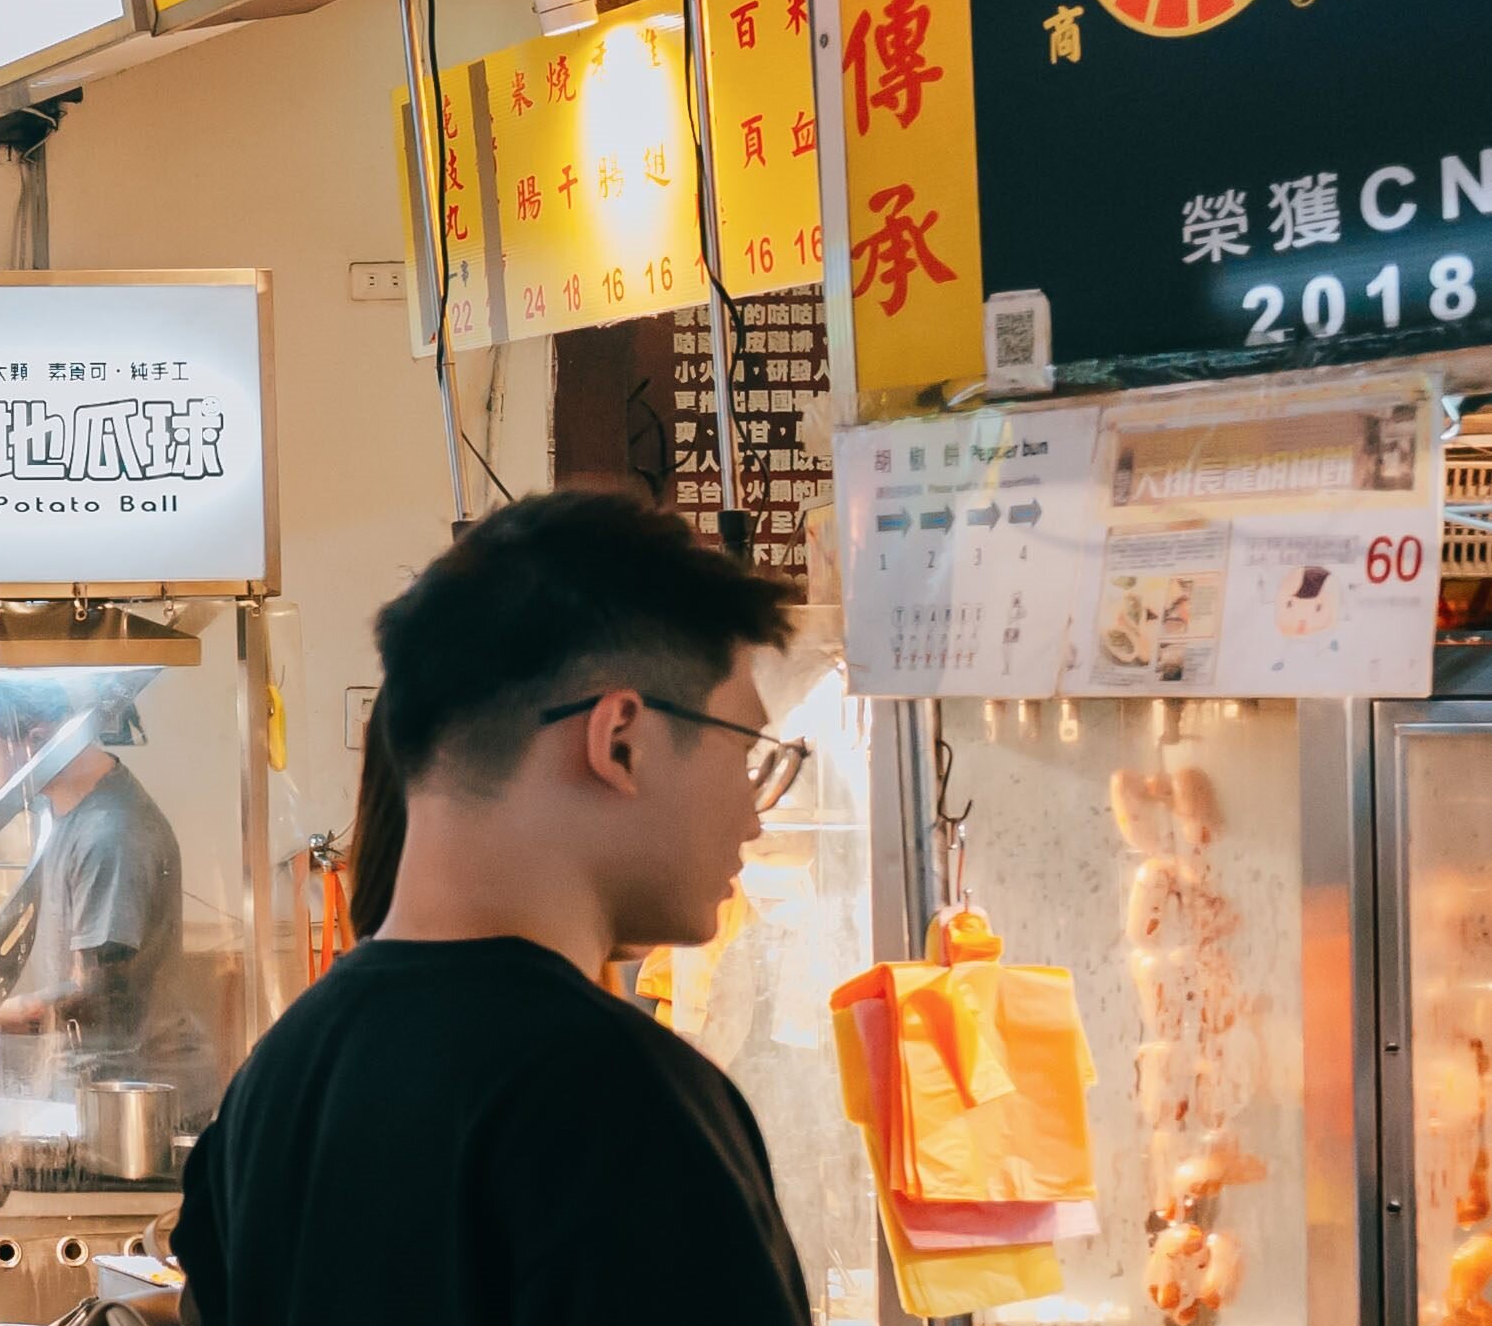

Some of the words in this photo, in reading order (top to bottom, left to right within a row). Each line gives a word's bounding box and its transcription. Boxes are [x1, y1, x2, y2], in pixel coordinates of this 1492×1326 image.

[744, 236, 774, 275] 16
[562, 273, 582, 312] 18
[602, 267, 625, 304] 16
[645, 256, 673, 295] 16
[523, 284, 547, 320] 24
[1241, 255, 1477, 348] 2018
[120, 494, 180, 515] Ball
[1365, 534, 1423, 585] 60
